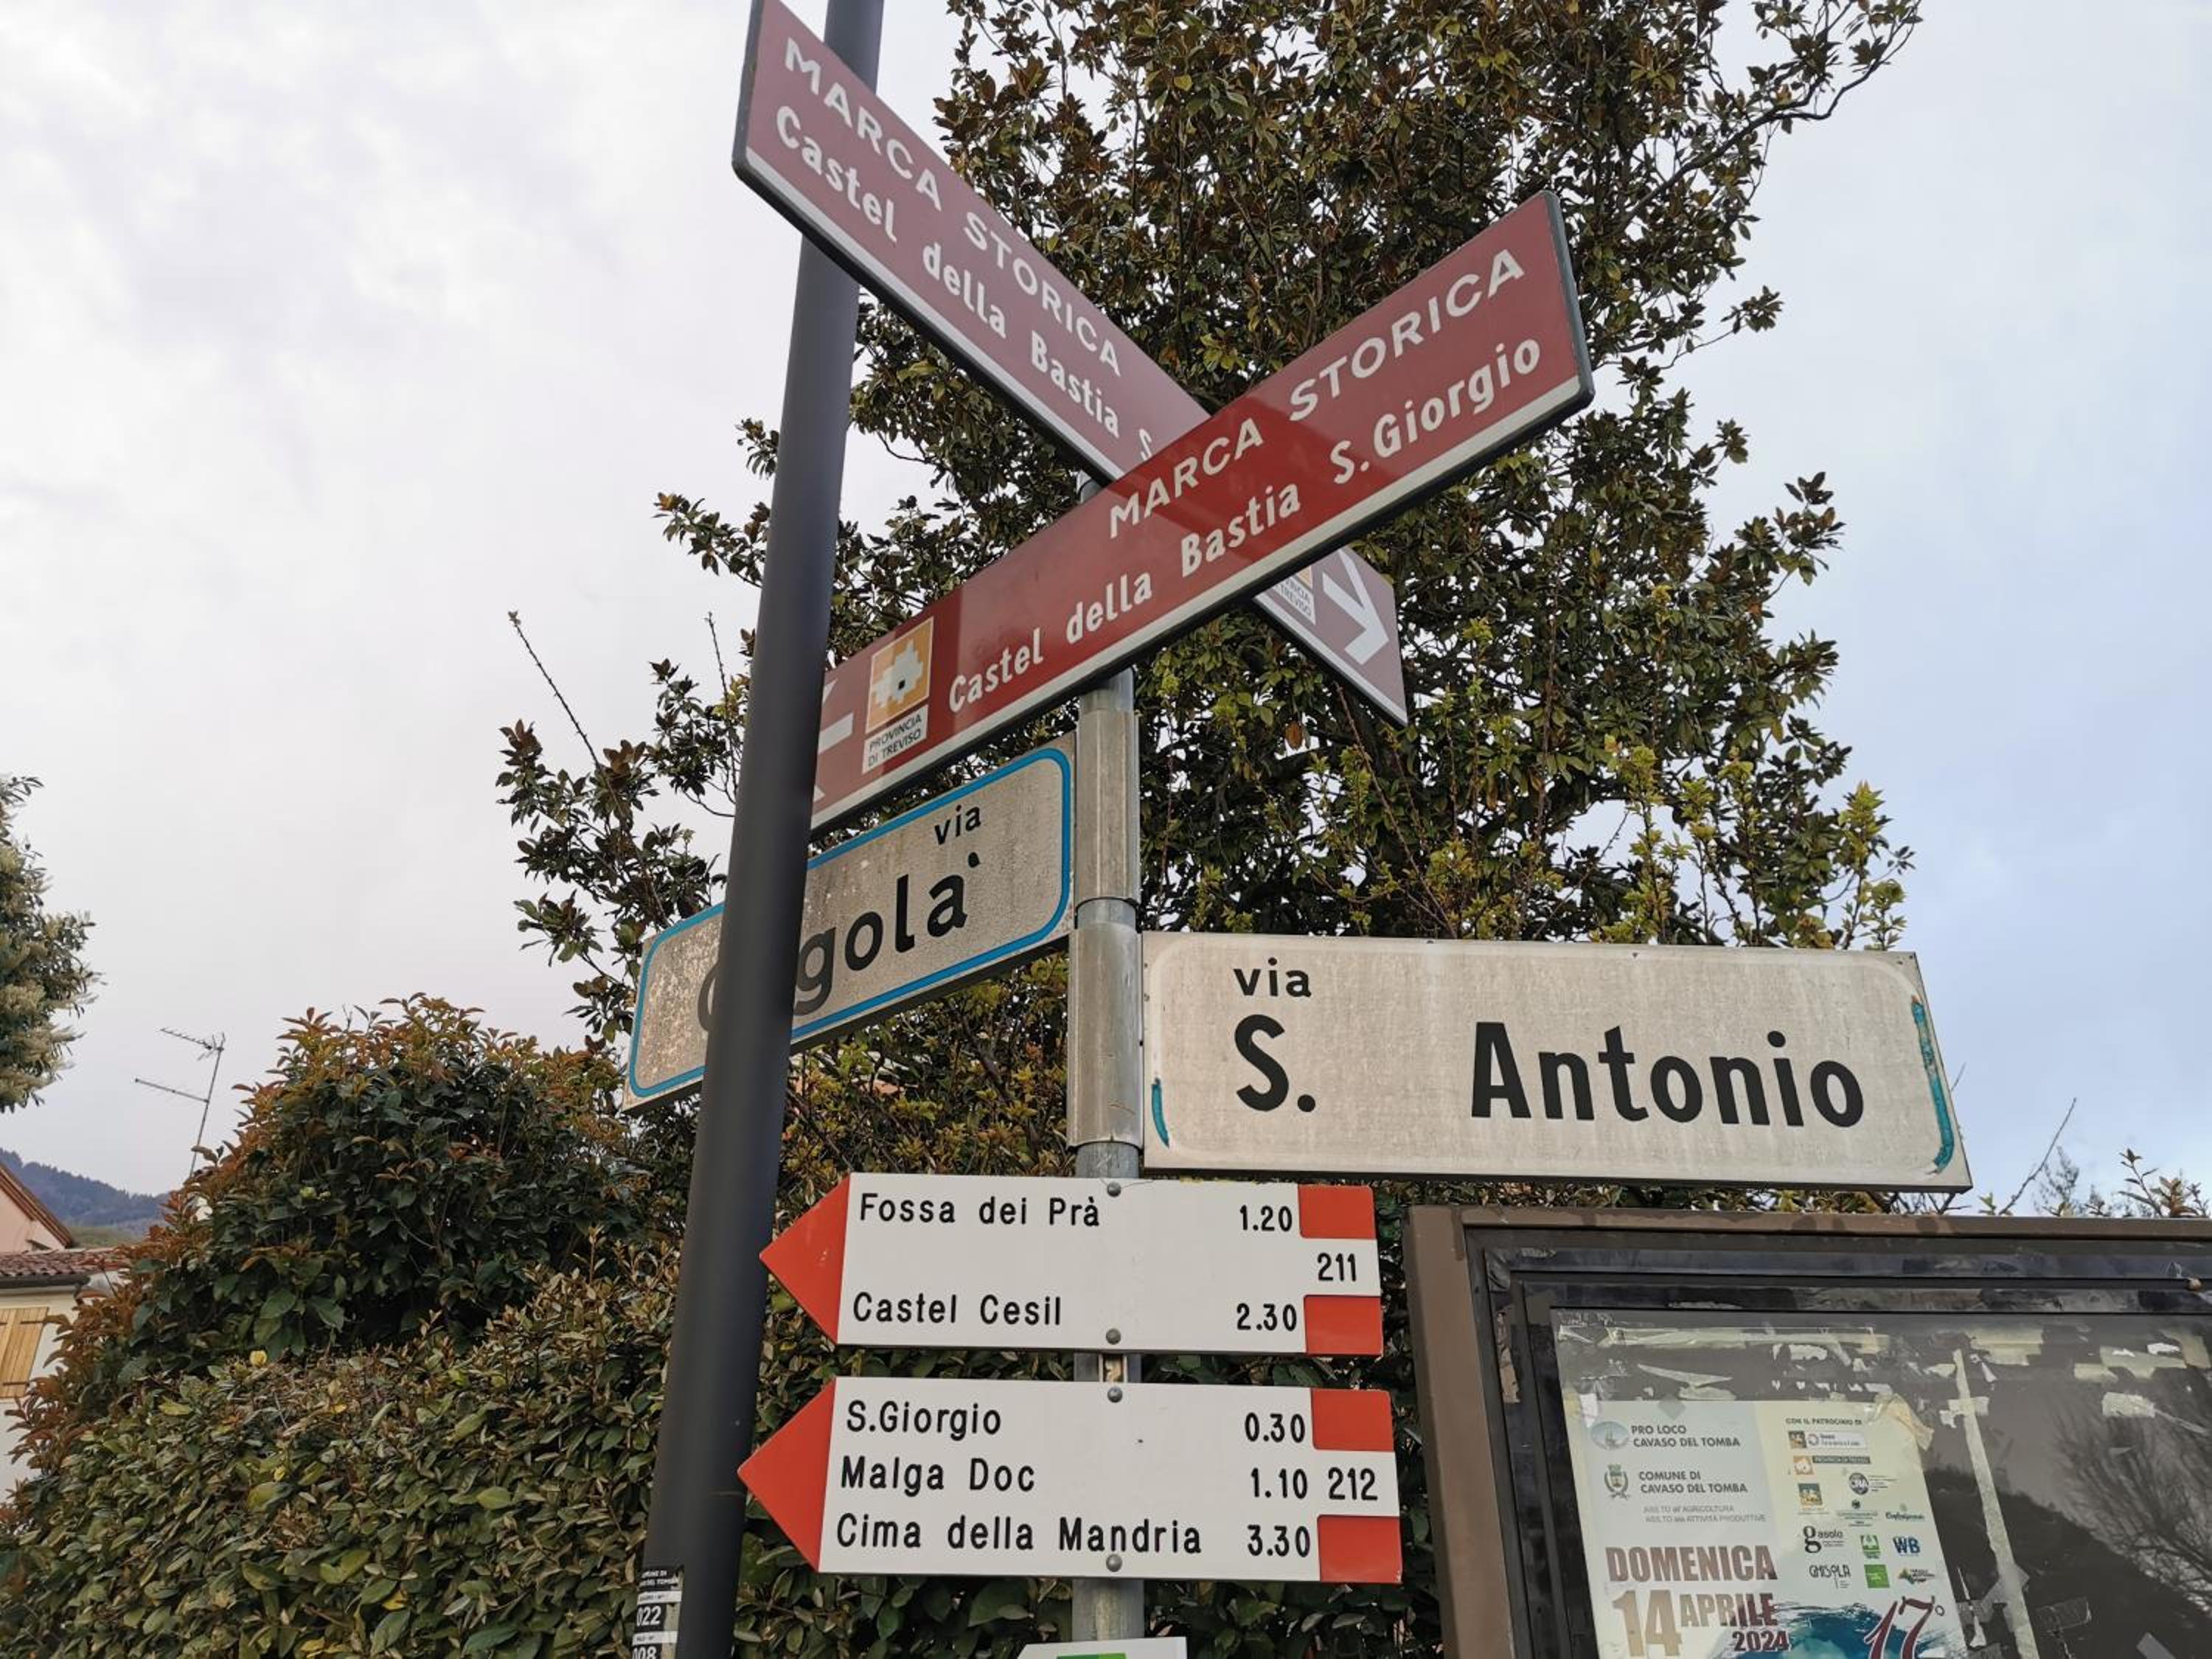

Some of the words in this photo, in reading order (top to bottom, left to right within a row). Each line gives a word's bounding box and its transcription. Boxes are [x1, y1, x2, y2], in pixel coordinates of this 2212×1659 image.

[785, 38, 942, 212] MARCA
[964, 212, 1121, 376] STORICA
[776, 105, 897, 242] Castel
[923, 242, 1006, 338] della
[1032, 330, 1120, 438] Bastia
[1110, 417, 1263, 538] MARCA
[1290, 248, 1525, 422] STORICA
[949, 628, 1043, 714] Castel
[1066, 571, 1153, 644] della
[1180, 483, 1301, 577] Bastia
[868, 754, 878, 767] DI
[883, 728, 921, 759] TREVISO
[870, 714, 922, 751] PROVINCIA
[934, 804, 981, 844] via
[1234, 957, 1312, 998] via
[1234, 1014, 1316, 1113] S.
[1471, 1021, 1864, 1128] Antonio
[860, 1193, 956, 1224] Fossa
[978, 1196, 1027, 1225] dei
[1050, 1196, 1100, 1227] Prà
[1239, 1205, 1293, 1232] 1.20
[1318, 1253, 1357, 1282] 211
[853, 1292, 957, 1323] Castel
[980, 1294, 1061, 1326] Cesil
[1237, 1304, 1298, 1331] 2.30
[846, 1400, 1001, 1441] S.Giorgio
[1245, 1413, 1305, 1443] 0.30
[1631, 1425, 1654, 1434] PRO
[1658, 1425, 1687, 1435] LOCO
[1633, 1438, 1677, 1447] CAVASO
[1680, 1438, 1698, 1447] DEL
[1702, 1438, 1741, 1447] TOMBA
[841, 1455, 945, 1497] Malga
[970, 1458, 1035, 1492] Doc
[1251, 1468, 1308, 1499] 1.10
[1328, 1467, 1378, 1500] 212
[1639, 1471, 1686, 1481] COMUNE
[1689, 1471, 1701, 1480] DI
[1641, 1484, 1684, 1493] CAVASO
[1688, 1484, 1705, 1492] DEL
[1710, 1484, 1748, 1493] TOMBA
[837, 1512, 922, 1548] Cima
[947, 1514, 1034, 1550] della
[1059, 1517, 1201, 1554] Mandria
[1247, 1525, 1310, 1558] 3.30
[1605, 1545, 1777, 1582] DOMENICA
[1612, 1590, 1683, 1656] 14
[1680, 1593, 1778, 1627] APRILE
[1733, 1630, 1792, 1652] 2024
